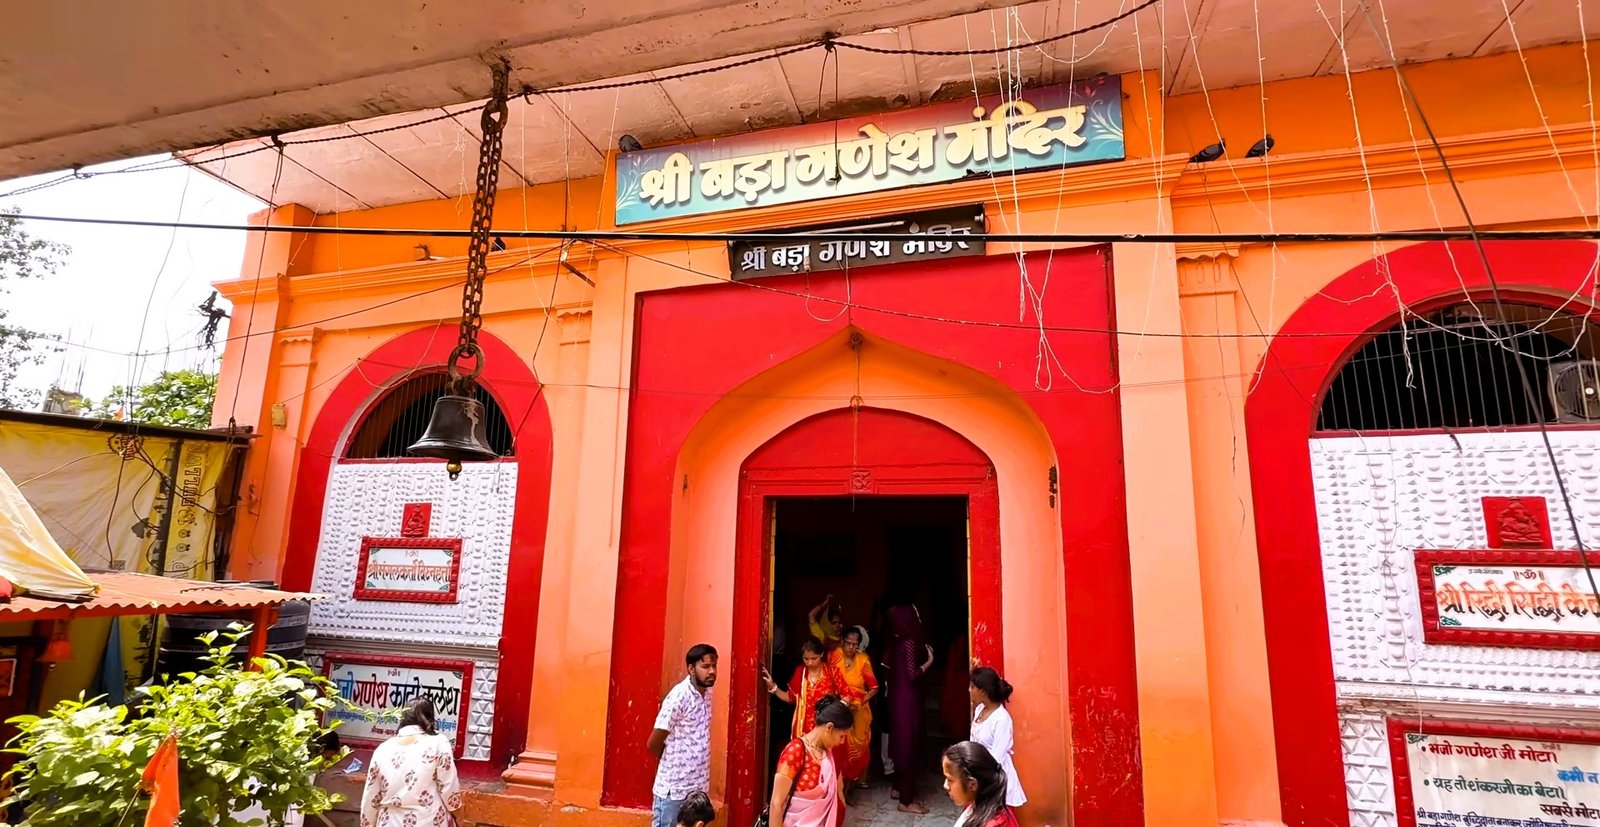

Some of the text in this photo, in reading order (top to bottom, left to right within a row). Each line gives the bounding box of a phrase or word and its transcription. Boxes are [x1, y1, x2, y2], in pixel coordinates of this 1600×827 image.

[640, 99, 1088, 206] श्री बड़ा गणेश मंदिर
[741, 246, 768, 271] श्री
[771, 243, 810, 272] बड़ा
[818, 238, 891, 263] गणश
[1437, 582, 1465, 614] श्री
[333, 671, 354, 701] जो
[353, 673, 390, 709] गणेश
[1428, 740, 1453, 755] भजो
[1454, 742, 1498, 759] गणेश
[1499, 743, 1516, 760] जी
[1433, 777, 1454, 792] यह
[1539, 802, 1574, 818] सबसे
